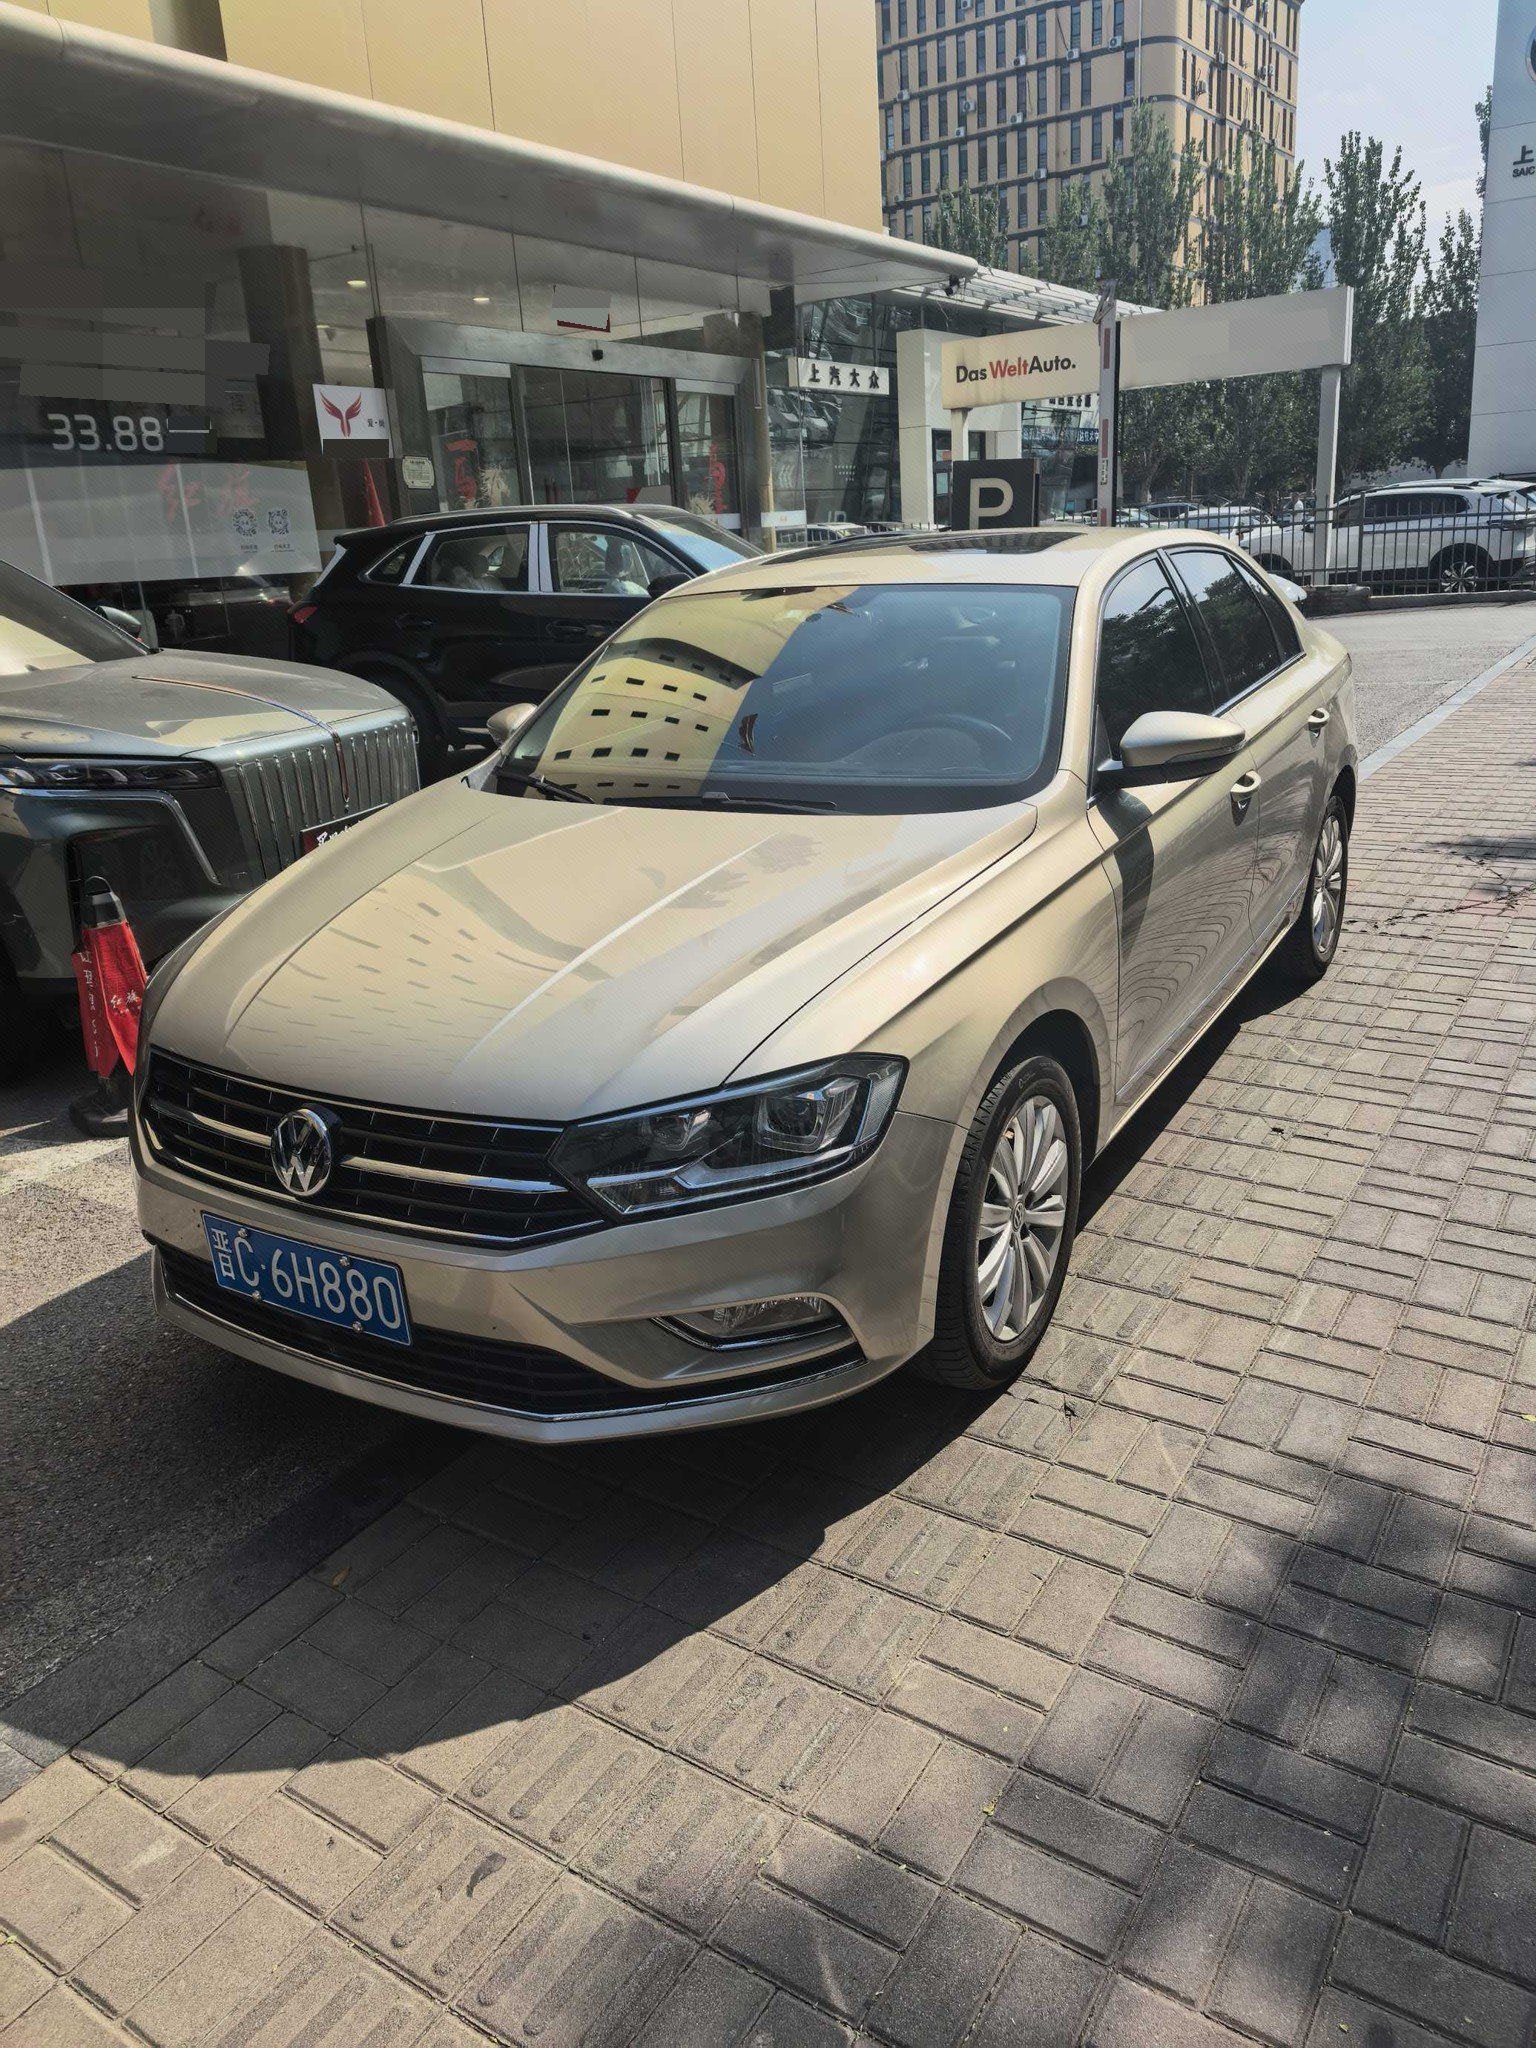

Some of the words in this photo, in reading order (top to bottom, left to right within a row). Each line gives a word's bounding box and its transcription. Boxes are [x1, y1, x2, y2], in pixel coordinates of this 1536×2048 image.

[1512, 166, 1536, 178] SAIC
[808, 363, 880, 389] 上汽大众
[956, 365, 988, 383] Das
[47, 413, 164, 452] 33.88
[969, 477, 1014, 530] P
